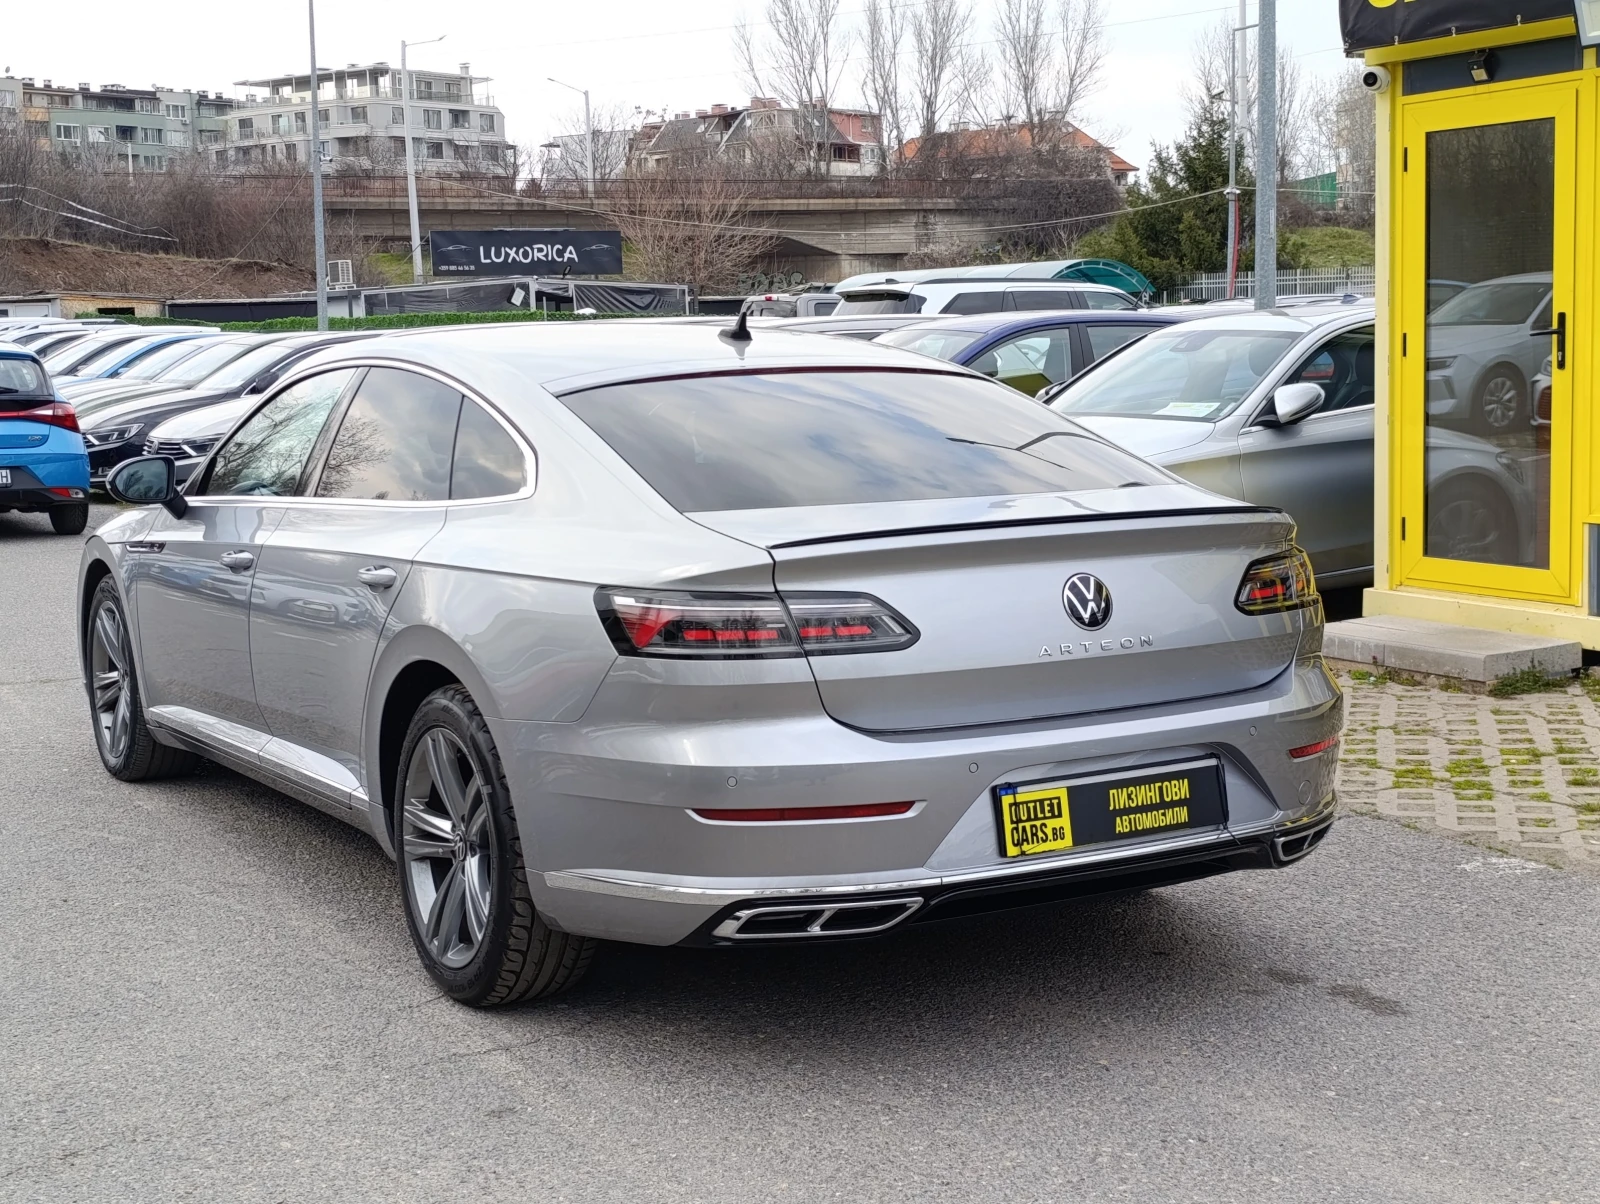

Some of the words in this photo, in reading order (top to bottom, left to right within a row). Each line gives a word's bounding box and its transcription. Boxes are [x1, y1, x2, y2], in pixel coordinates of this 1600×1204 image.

[479, 243, 579, 264] LUXORICA
[1038, 635, 1154, 658] ARTEON
[1109, 778, 1190, 811] ЛИЗИНГОВИ
[1011, 799, 1059, 822] OUTLET
[1115, 806, 1189, 834] АВТОМОБИЛИ
[1010, 822, 1066, 848] CARS.BG
